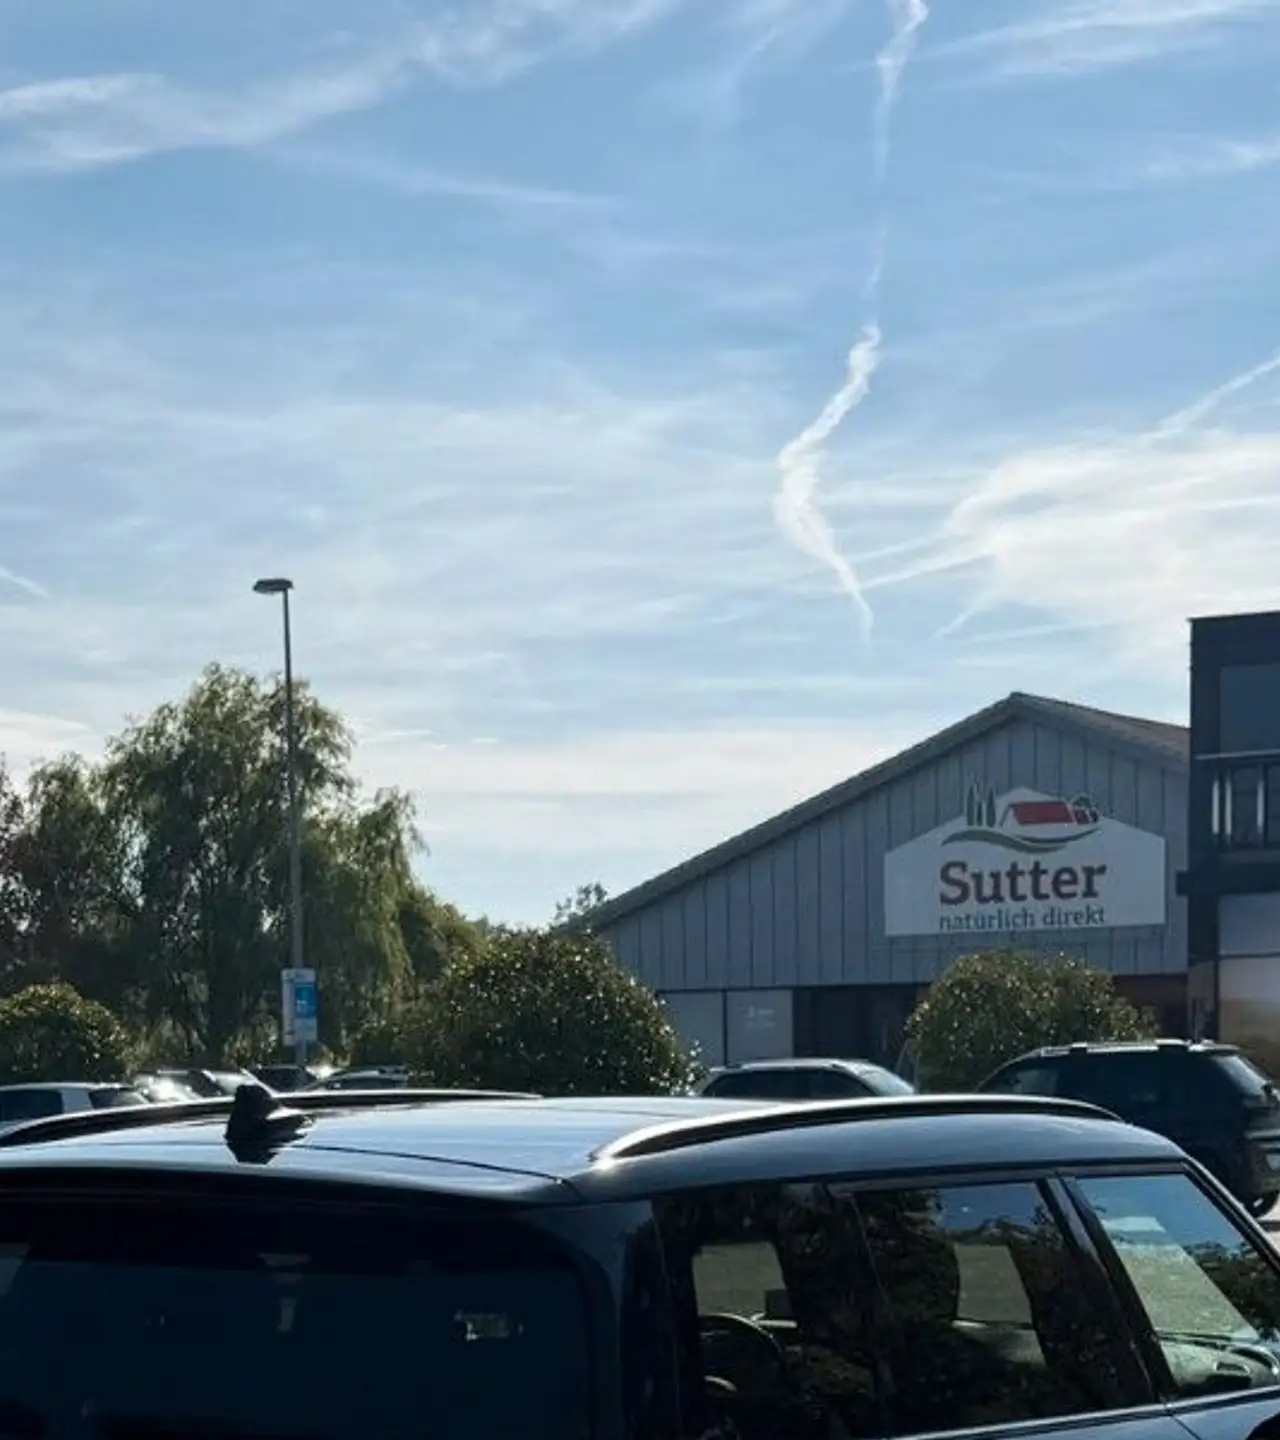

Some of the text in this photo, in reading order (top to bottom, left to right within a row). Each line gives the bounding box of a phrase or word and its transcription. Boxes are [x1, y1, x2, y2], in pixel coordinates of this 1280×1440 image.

[939, 859, 1107, 906] Sutter
[938, 902, 1106, 932] natürlich direkt
